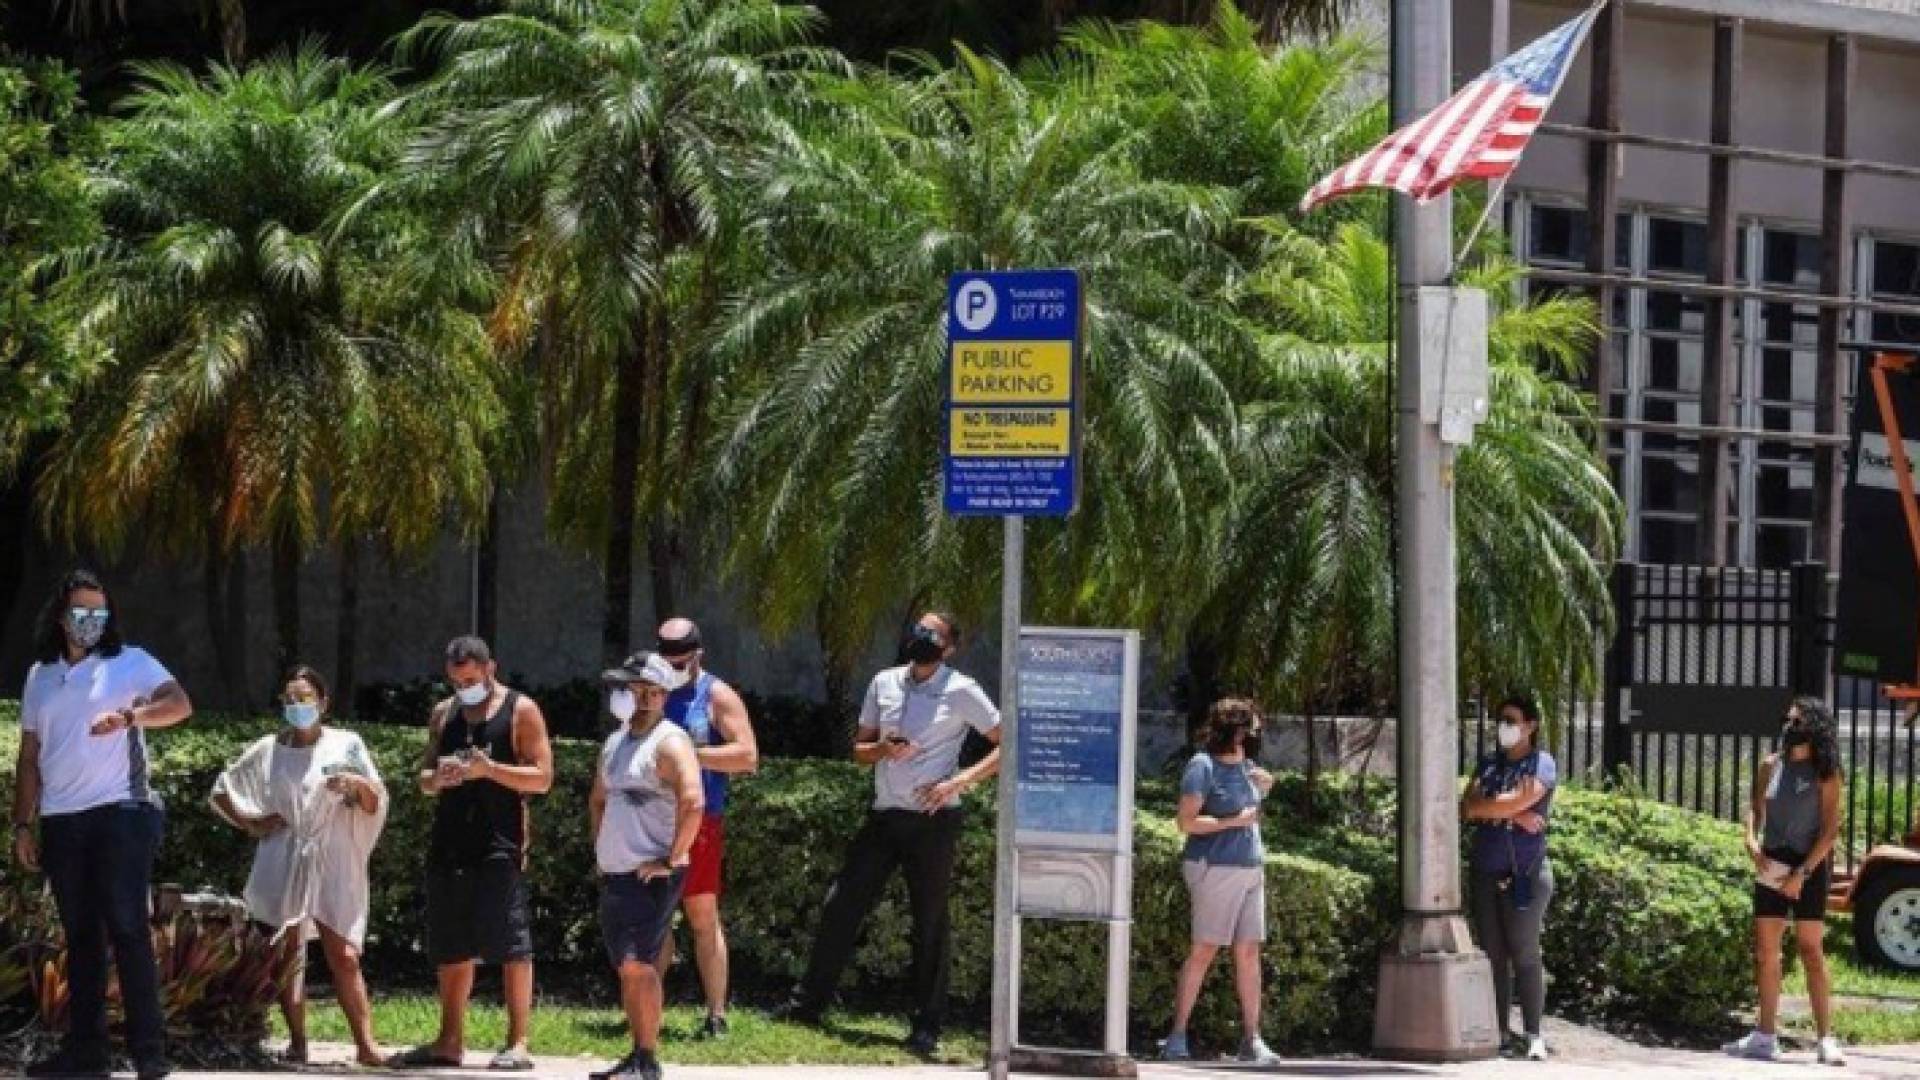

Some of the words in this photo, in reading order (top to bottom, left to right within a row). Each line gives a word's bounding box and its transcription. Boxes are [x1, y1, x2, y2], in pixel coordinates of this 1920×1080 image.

[966, 290, 987, 321] P
[1011, 303, 1036, 320] LOT
[961, 348, 1033, 369] PUBLIC
[960, 372, 1054, 394] PARKING
[963, 412, 980, 427] NO
[985, 412, 1057, 427] TRESPASSING
